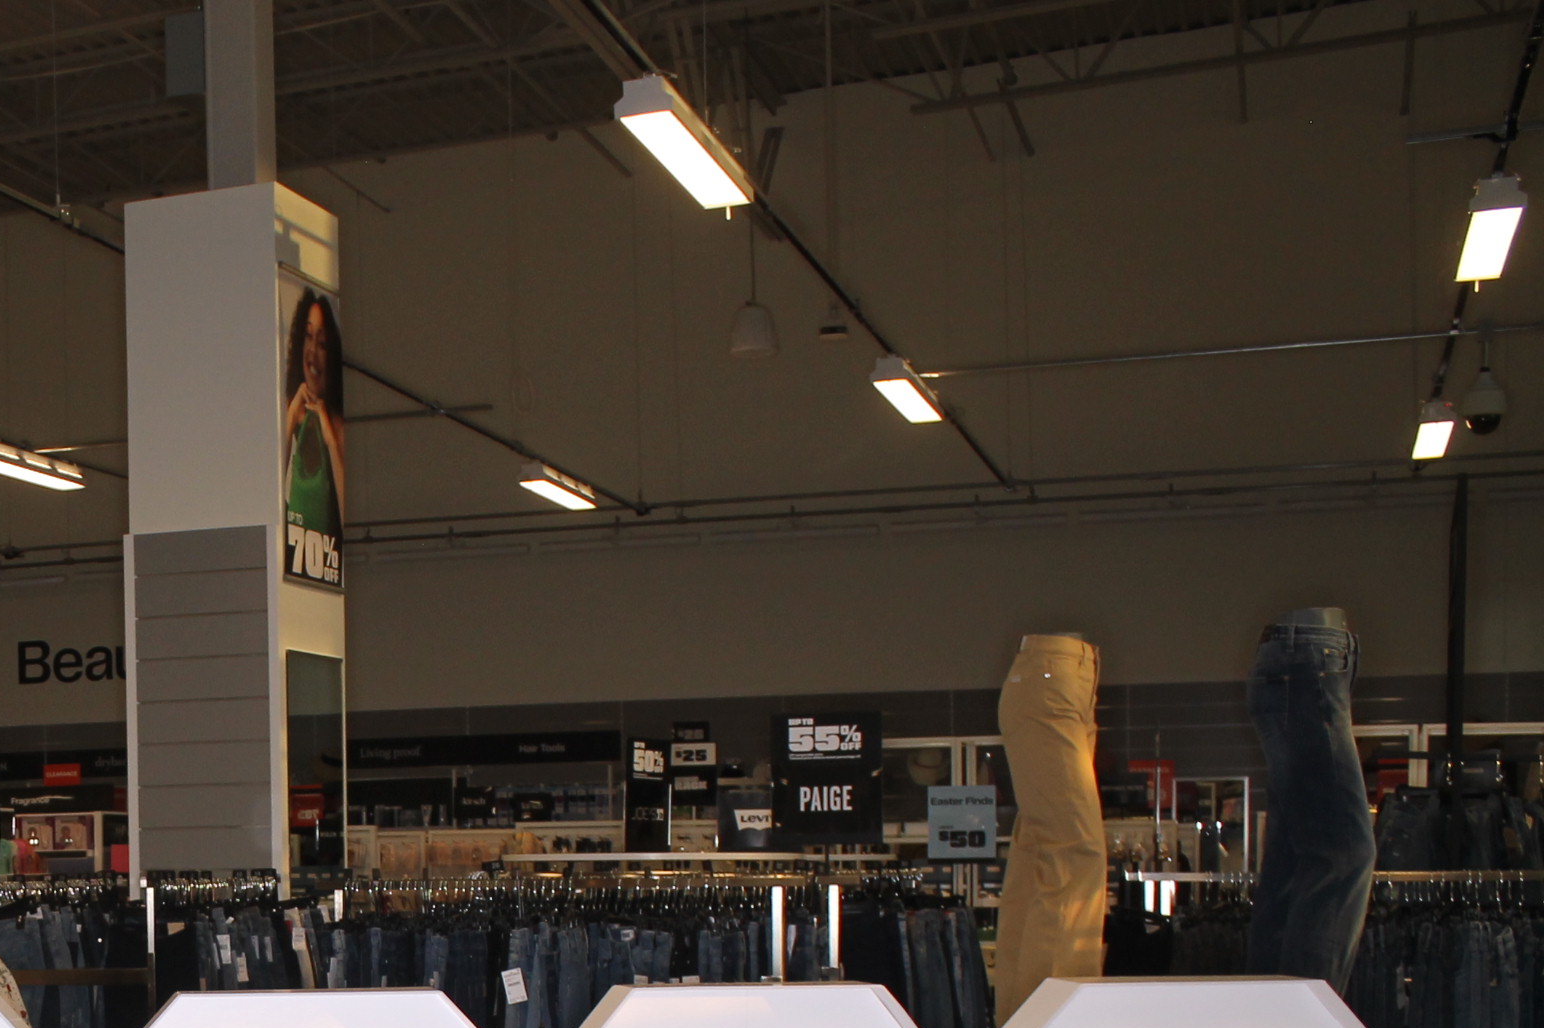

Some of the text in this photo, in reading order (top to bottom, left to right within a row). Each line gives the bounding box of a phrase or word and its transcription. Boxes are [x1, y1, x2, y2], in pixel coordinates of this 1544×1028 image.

[288, 523, 338, 579] 70%
[324, 567, 338, 583] OFF
[788, 724, 861, 752] 55%
[839, 742, 861, 751] OFF
[675, 749, 707, 762] $25
[11, 797, 50, 806] Fragrance
[799, 785, 853, 812] PAIGE
[930, 797, 993, 805] Easter Finds
[939, 831, 985, 848] $50
